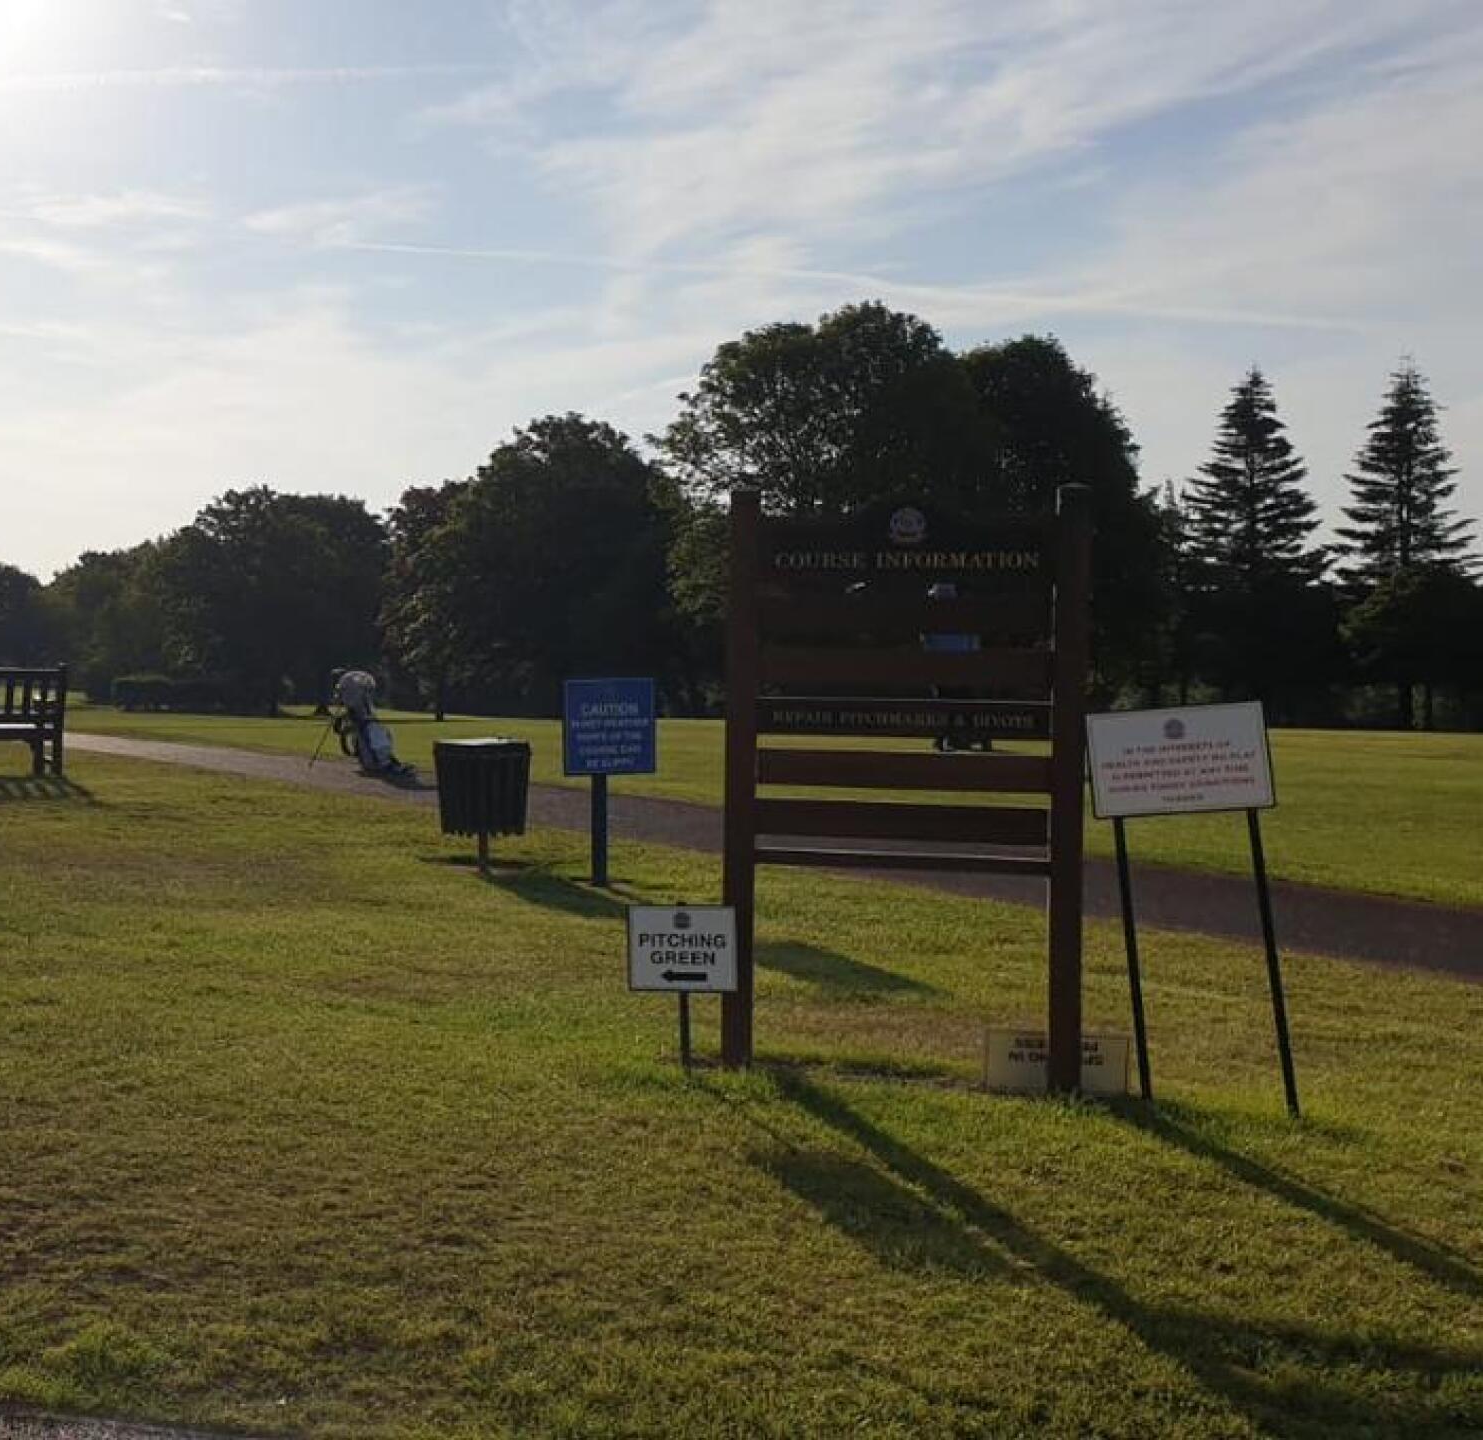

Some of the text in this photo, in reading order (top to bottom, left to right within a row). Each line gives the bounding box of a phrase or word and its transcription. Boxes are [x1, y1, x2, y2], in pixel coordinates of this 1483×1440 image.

[774, 552, 1039, 569] COURSE INFORMATION
[580, 702, 639, 716] CAUTION
[773, 711, 1034, 728] REPAIR PITCHMARKS & DIVOTS
[1101, 759, 1140, 769] HEALTH
[1169, 754, 1208, 764] SAFETY
[638, 933, 727, 949] PITCHING
[650, 951, 715, 966] GREEN
